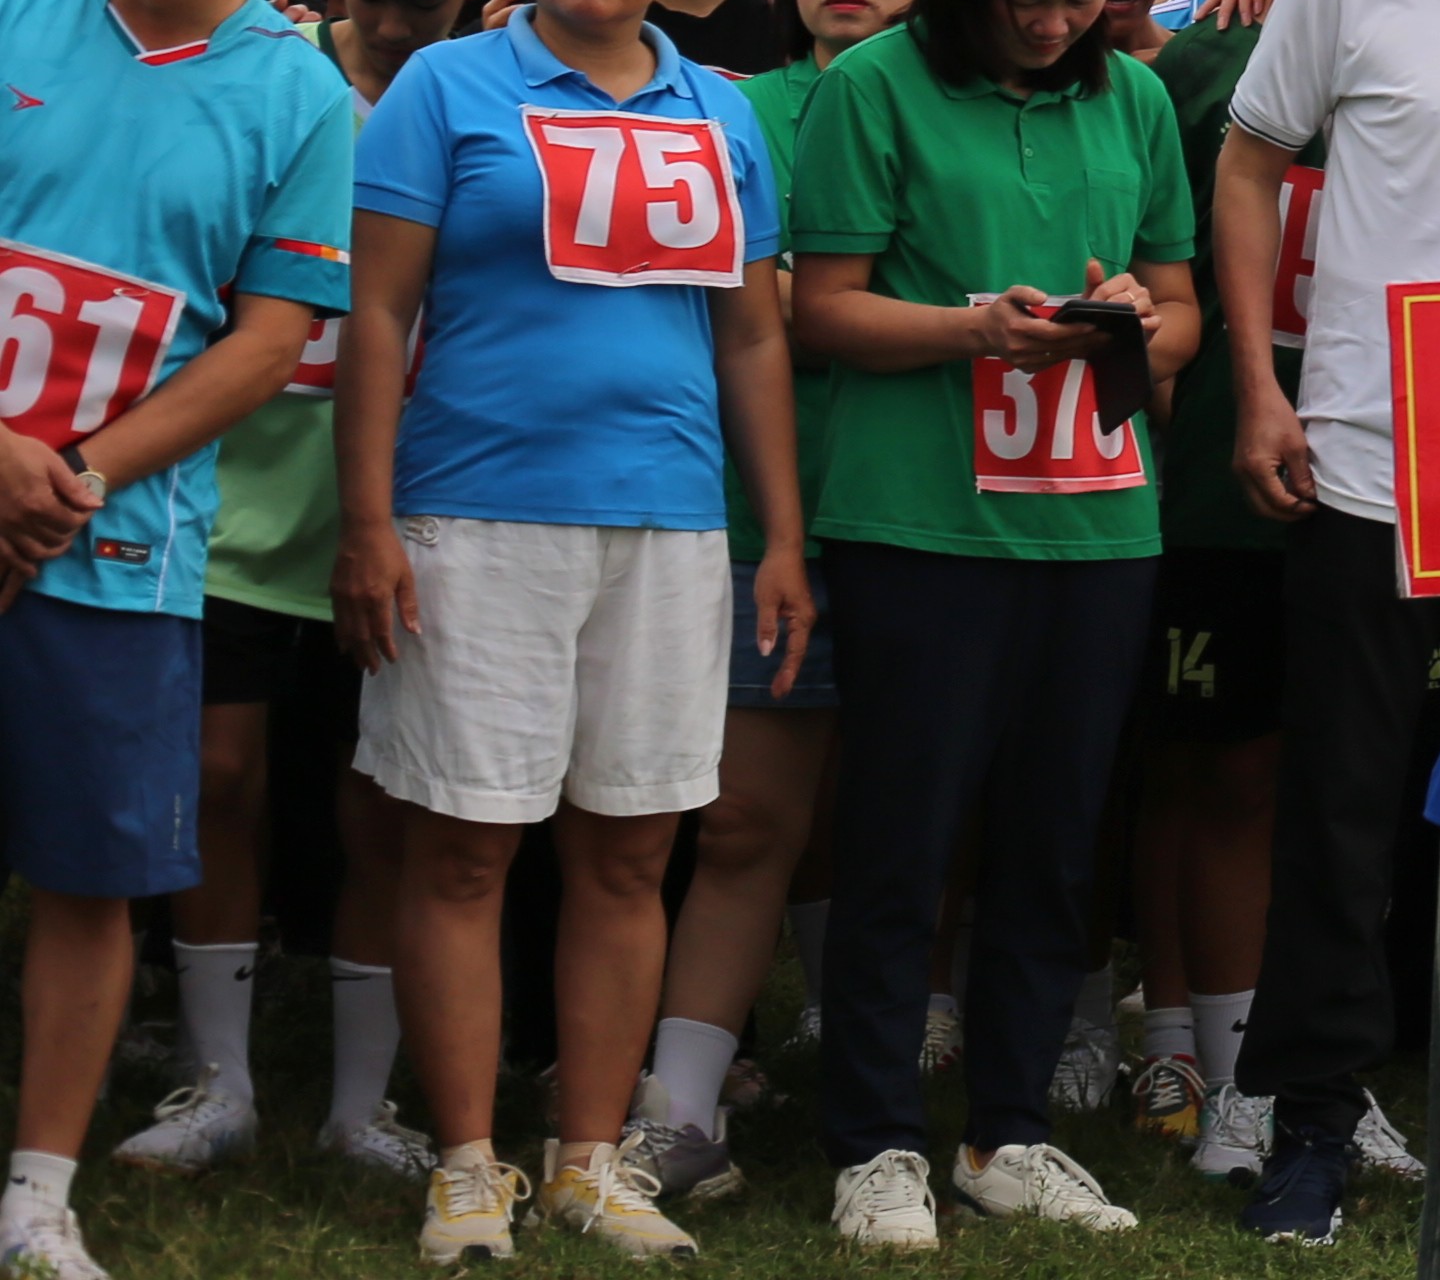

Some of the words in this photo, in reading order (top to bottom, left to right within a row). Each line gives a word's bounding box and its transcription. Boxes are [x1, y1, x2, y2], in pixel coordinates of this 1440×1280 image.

[541, 124, 721, 251] 75
[0, 267, 145, 432] 61
[1167, 627, 1215, 698] 14
